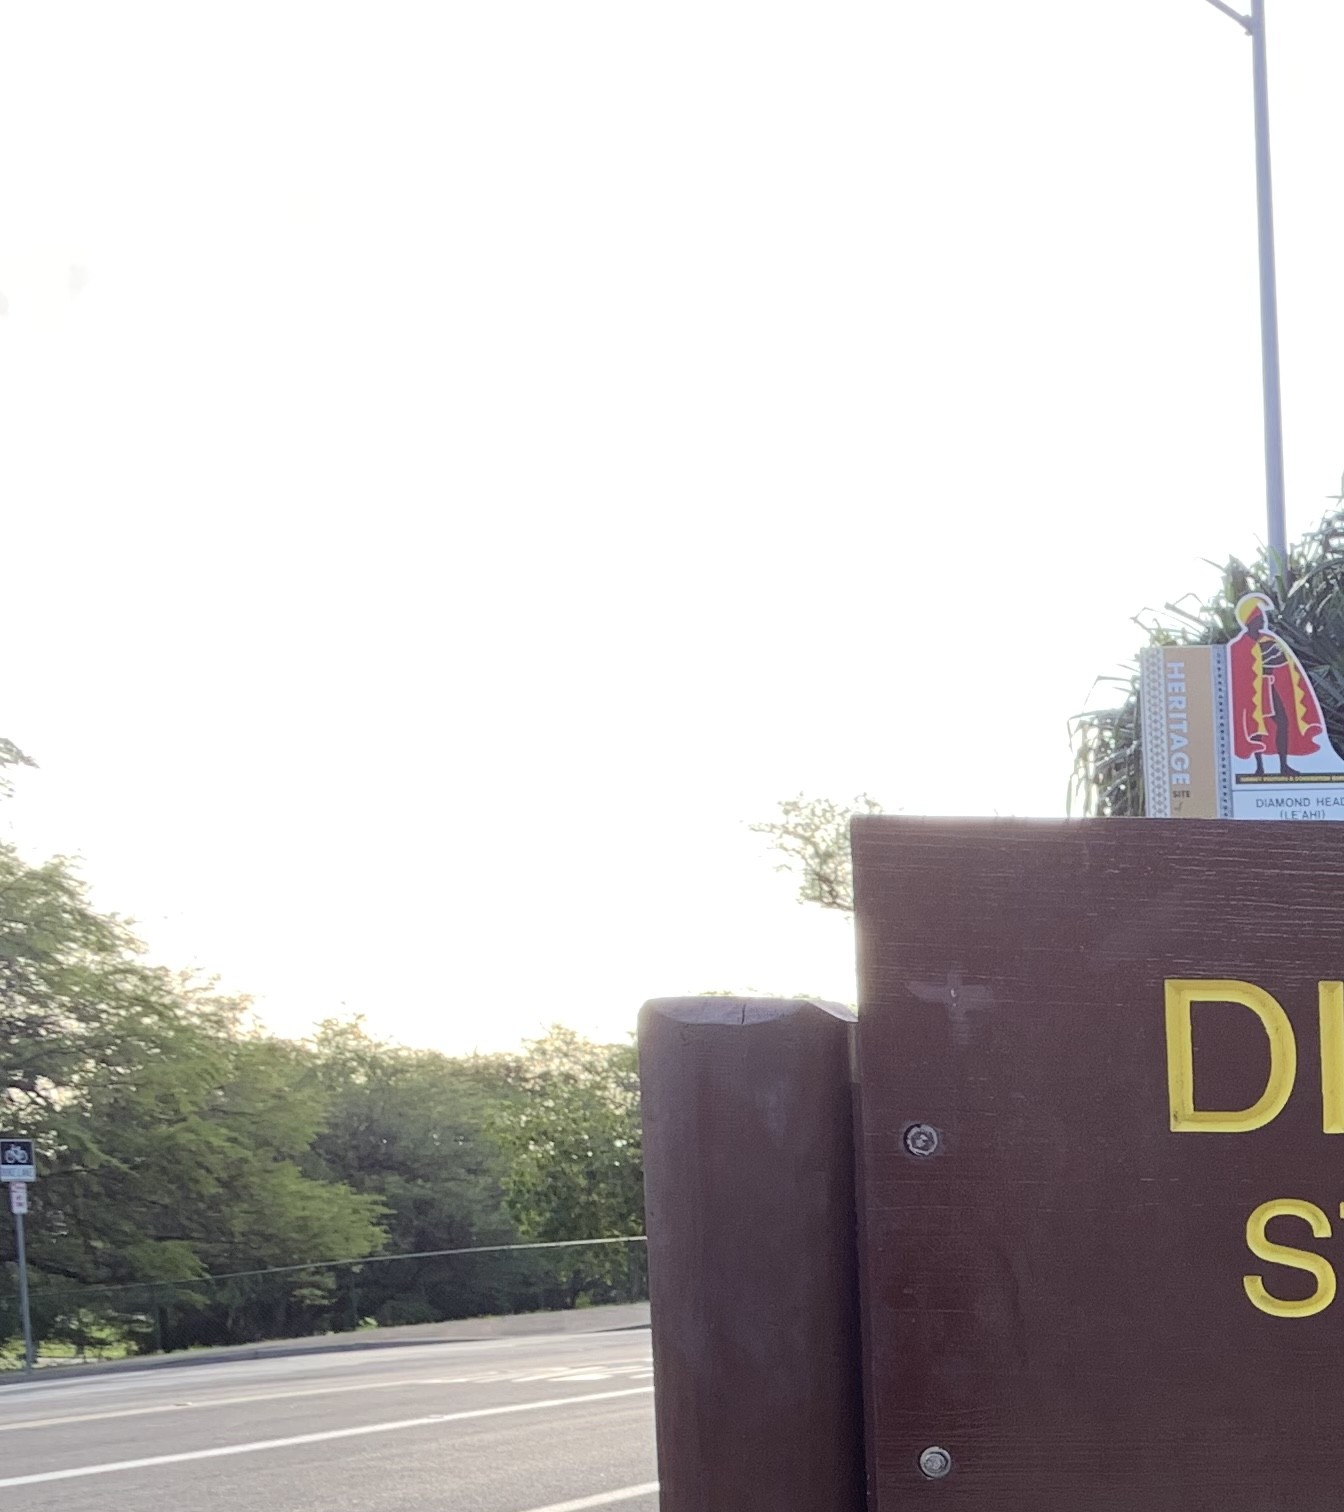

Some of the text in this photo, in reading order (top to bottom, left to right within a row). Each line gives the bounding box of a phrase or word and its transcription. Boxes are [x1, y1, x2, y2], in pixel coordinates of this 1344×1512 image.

[1166, 661, 1191, 785] HERITAGE
[1172, 790, 1191, 799] SITE
[1255, 797, 1311, 808] DIAMOND
